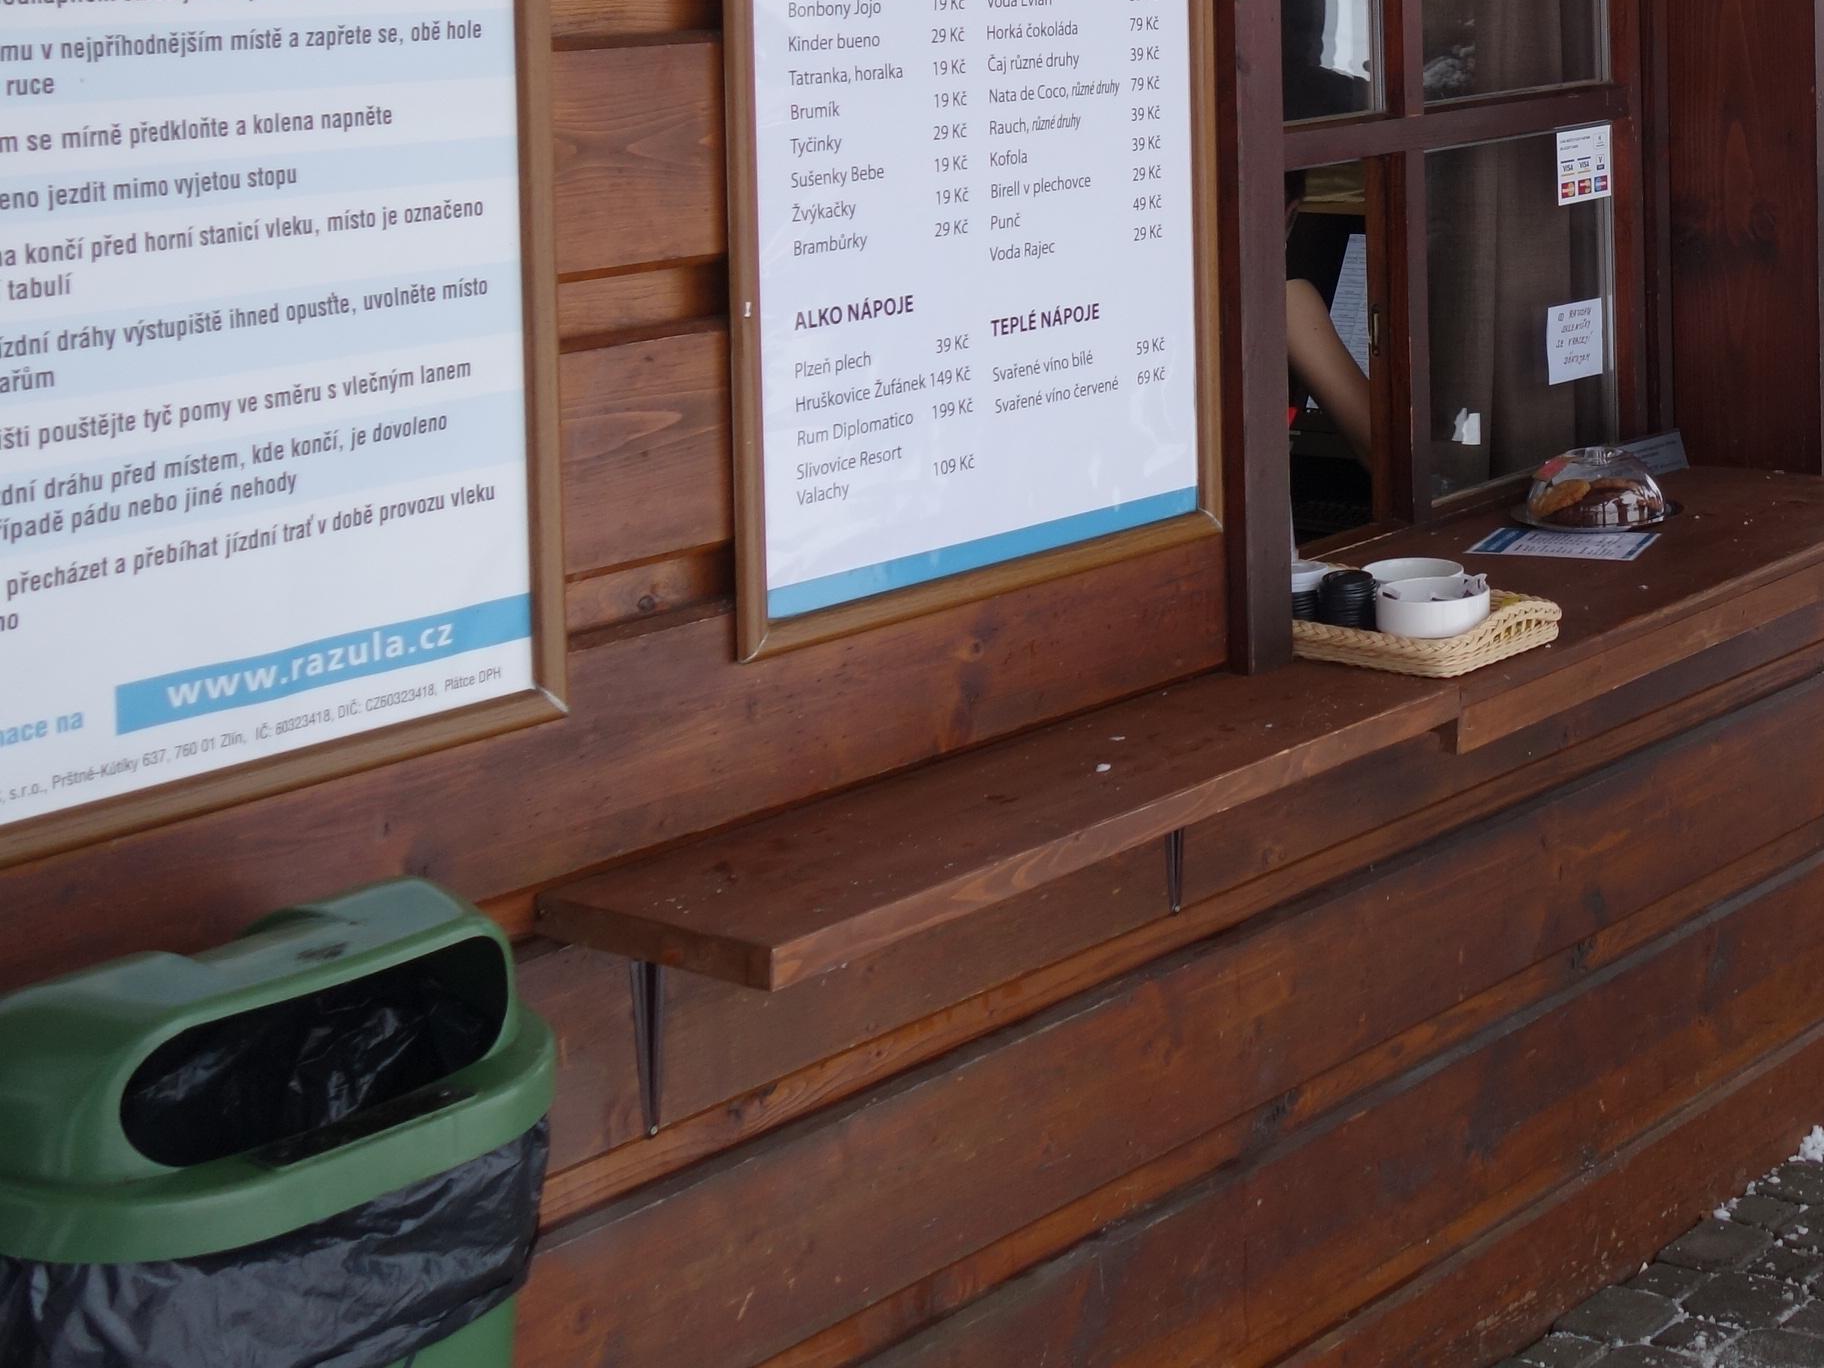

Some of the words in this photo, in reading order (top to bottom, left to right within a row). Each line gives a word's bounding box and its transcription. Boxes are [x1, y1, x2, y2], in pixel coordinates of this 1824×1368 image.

[788, 0, 851, 21] Bonbony
[987, 23, 1023, 40] Horká
[1026, 20, 1078, 40] čokoláda
[1130, 17, 1143, 31] 79
[1146, 16, 1159, 31] Kč
[788, 34, 834, 52] Kinder
[837, 32, 880, 49] bueno
[931, 28, 946, 43] 29
[950, 27, 965, 42] Kč
[795, 306, 842, 330] ALKO
[848, 295, 913, 322] NÁPOJE
[991, 310, 1036, 336] TEPLÉ
[1041, 303, 1099, 328] NÁPOJE
[993, 359, 1042, 384] Svařené
[1044, 355, 1068, 373] víno
[1071, 350, 1095, 367] bílé
[1137, 340, 1149, 358] 59
[1152, 337, 1165, 352] Kč
[796, 387, 870, 413] Hruškovice
[874, 374, 926, 400] Žufánek
[928, 369, 954, 390] 149
[956, 365, 971, 383] Kč
[995, 390, 1043, 413] Svařené
[1045, 387, 1071, 403] víno
[1074, 376, 1118, 398] červené
[1137, 368, 1150, 385] 69
[1153, 366, 1168, 382] Kč
[7, 557, 108, 599] přecházet
[115, 558, 125, 574] a
[134, 537, 218, 575] přebíhat
[225, 524, 277, 559] jízdní
[283, 514, 313, 542] trať
[318, 519, 327, 534] v
[333, 504, 373, 531] době
[380, 495, 445, 526] provozu
[451, 484, 495, 507] vleku
[166, 621, 455, 710] www.razula.cz
